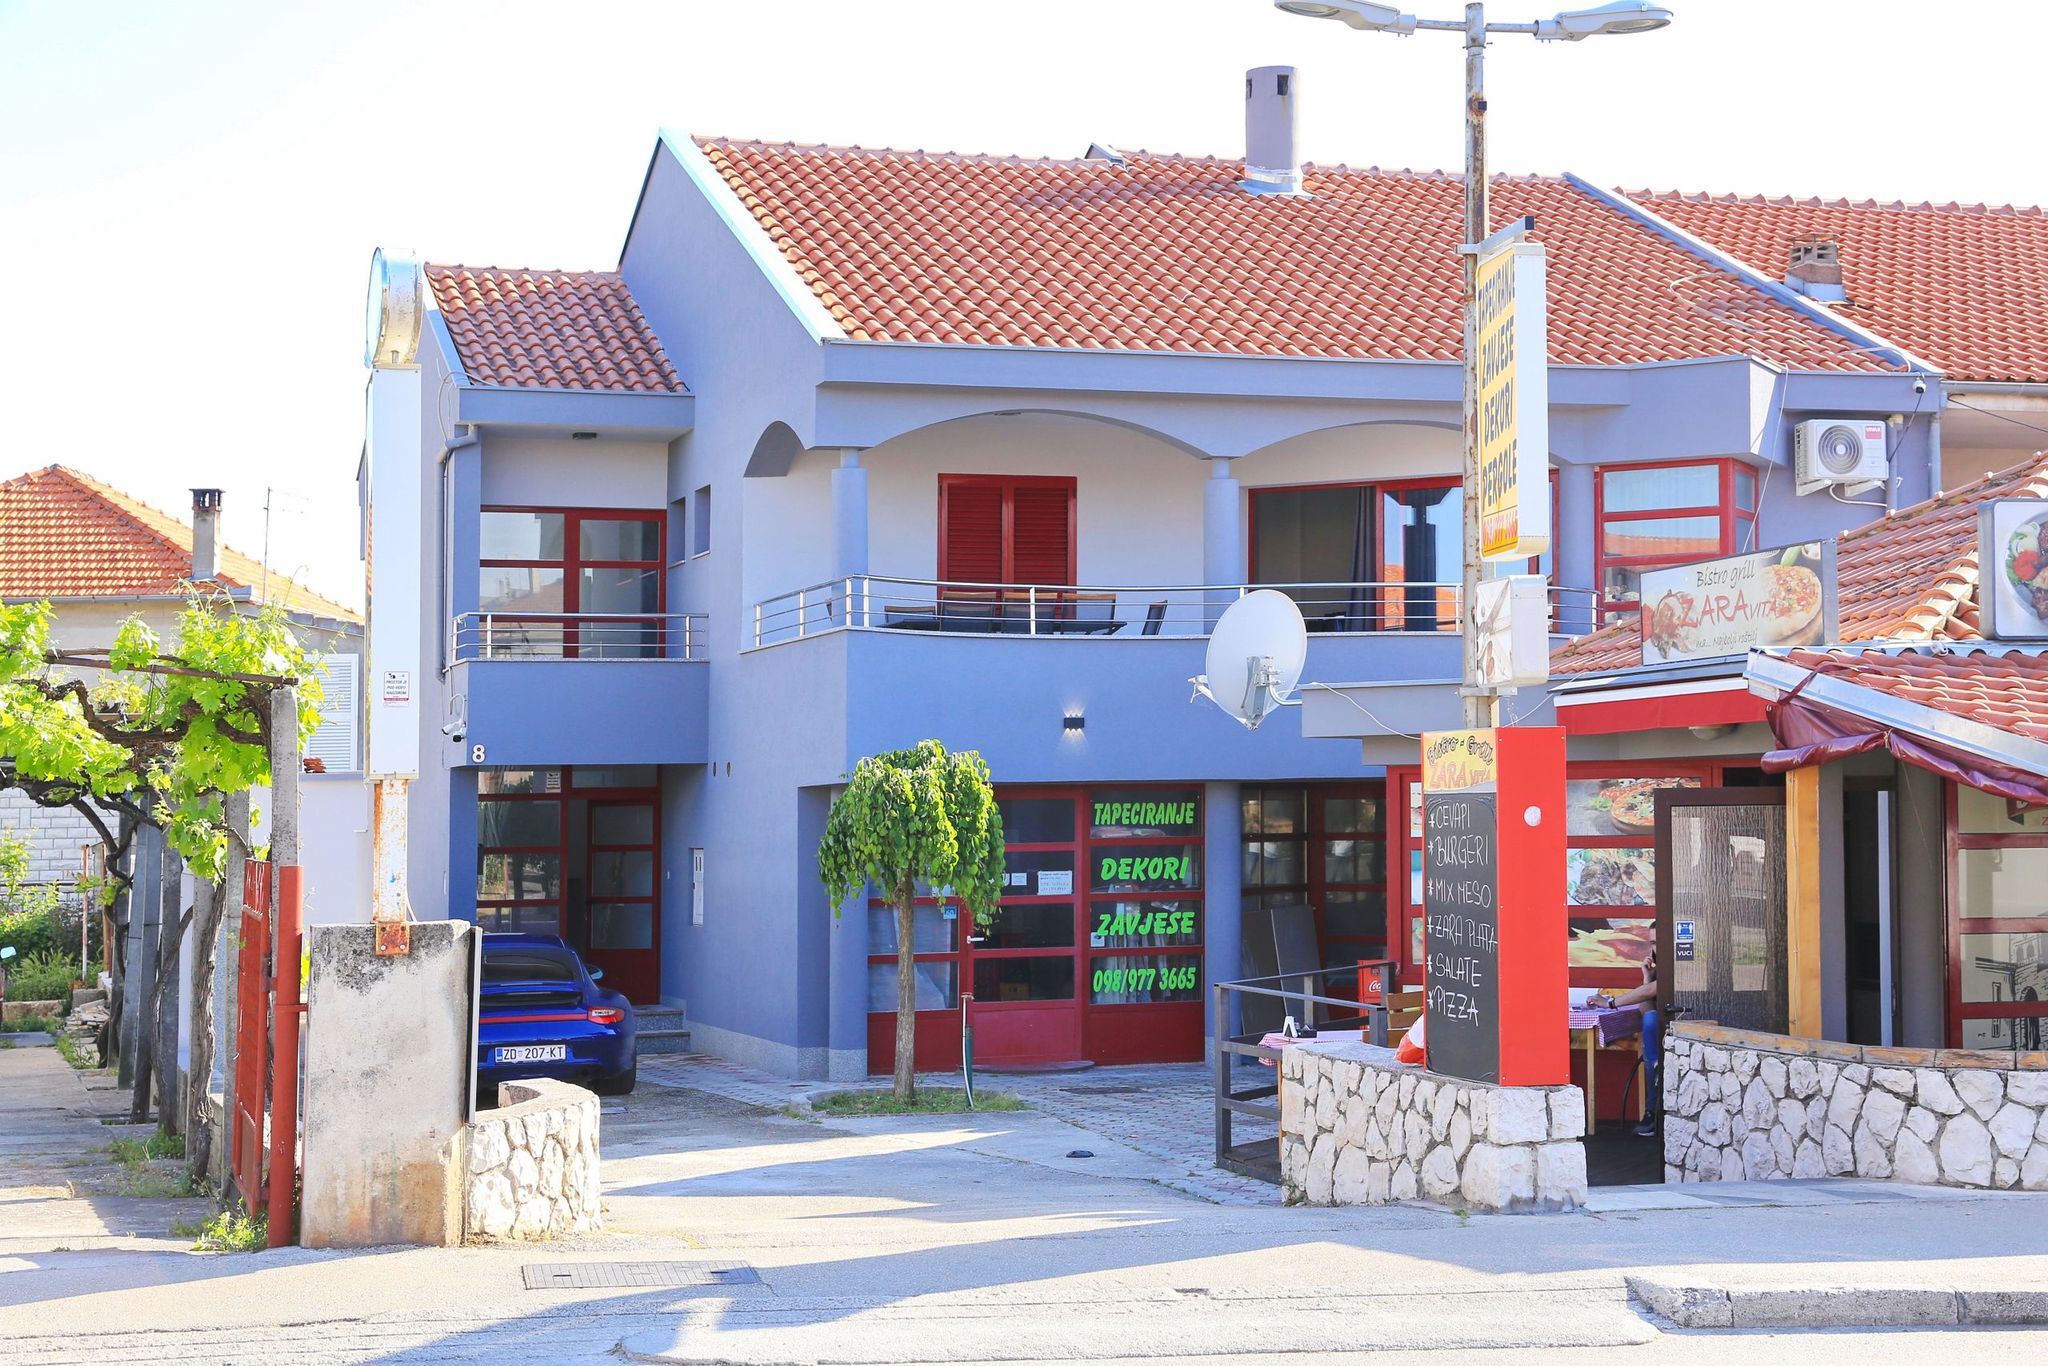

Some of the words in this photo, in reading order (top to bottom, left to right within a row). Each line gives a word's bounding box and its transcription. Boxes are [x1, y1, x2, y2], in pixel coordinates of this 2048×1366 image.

[1482, 315, 1514, 390] ZAVJESE
[1484, 377, 1513, 448] DEKORI
[1482, 439, 1517, 513] PERGOLE
[1696, 566, 1728, 588] Bistro
[1730, 559, 1756, 589] grill
[1679, 588, 1749, 628] ZARA
[471, 744, 486, 764] 8
[1429, 761, 1468, 789] ZARA
[1094, 802, 1195, 826] TAPECIRANJE
[1436, 802, 1470, 830] CEVAPI
[1435, 834, 1488, 869] BURGERI
[1100, 856, 1190, 882] DEKORI
[1435, 878, 1454, 905] MIX
[1097, 911, 1195, 936] ZAVJESE
[1434, 914, 1463, 946] ZARA
[1093, 968, 1156, 994] 098/977
[1159, 967, 1196, 991] 3665
[1435, 953, 1482, 987] SALATE
[1434, 985, 1479, 1027] PIZZA
[503, 1048, 517, 1060] ZD
[525, 1046, 563, 1059] 207-KT
